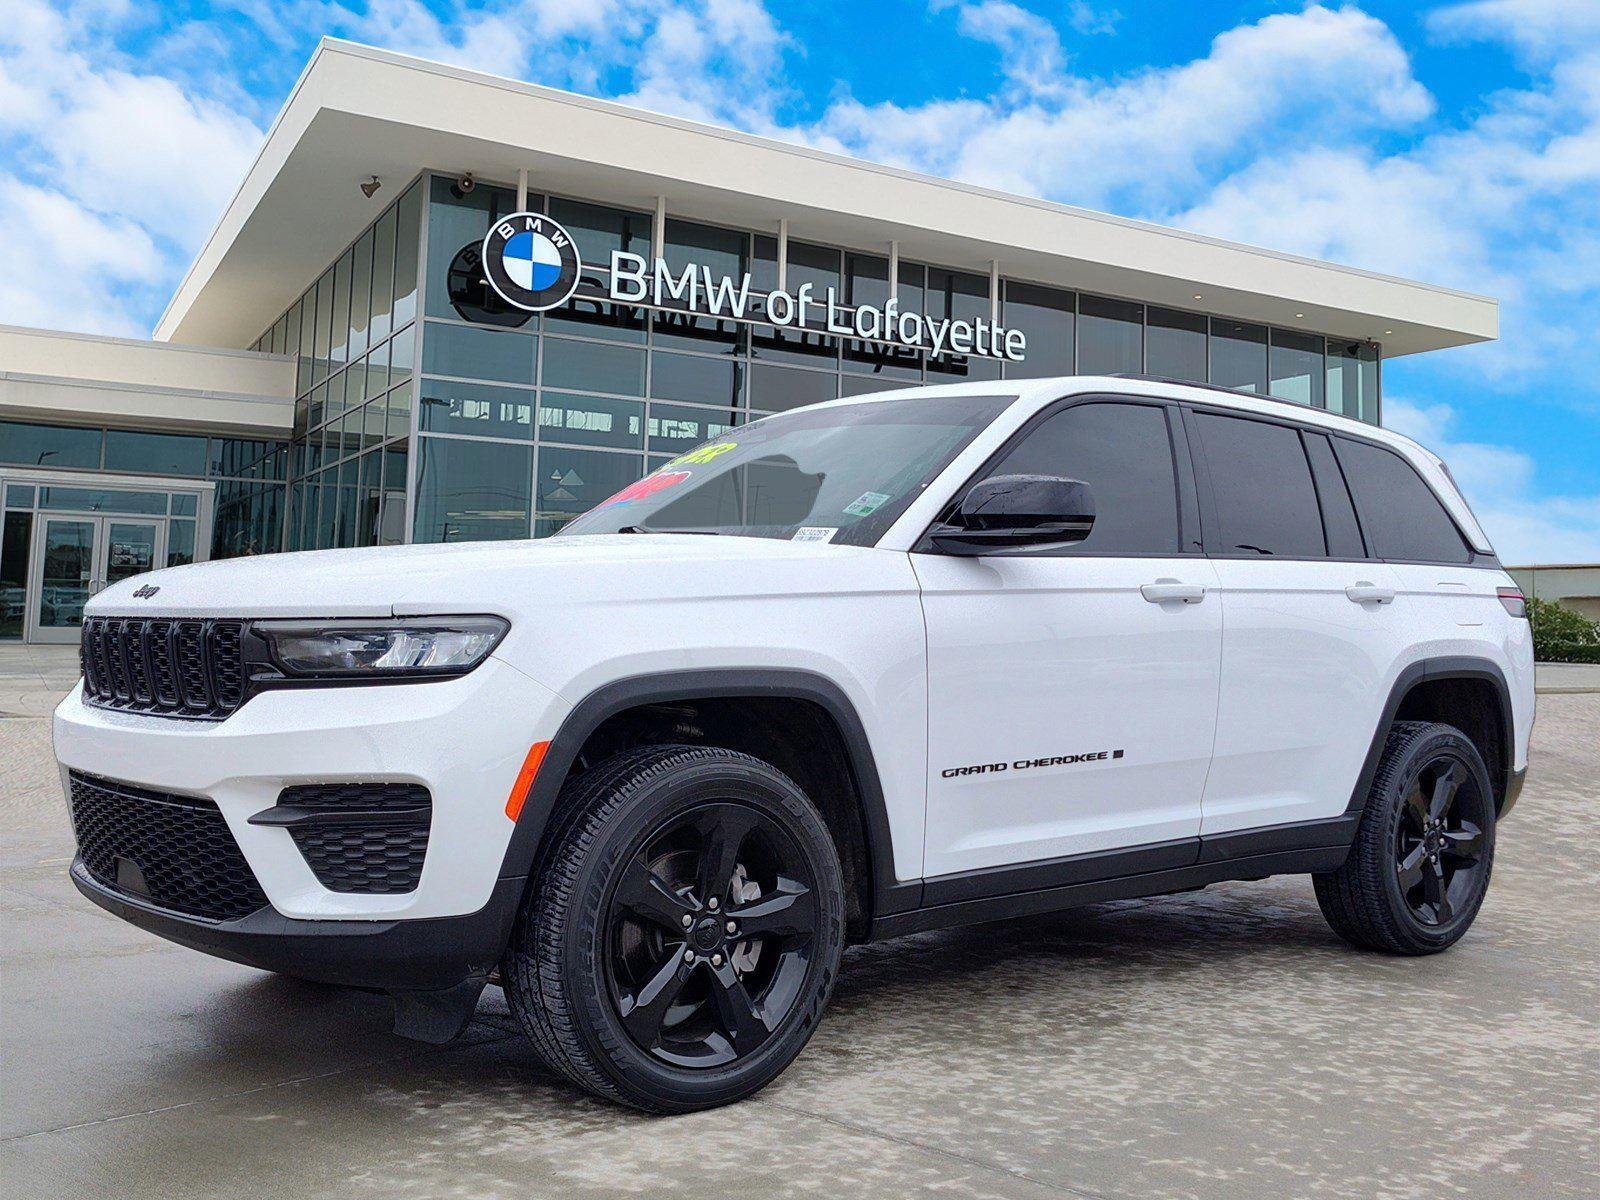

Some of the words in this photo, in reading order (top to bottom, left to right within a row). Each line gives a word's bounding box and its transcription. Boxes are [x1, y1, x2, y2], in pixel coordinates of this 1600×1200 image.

[497, 217, 569, 249] BMW
[609, 250, 751, 319] BMW
[766, 284, 813, 330] of
[827, 286, 1027, 362] Lafayette
[133, 584, 160, 600] Jeep
[942, 763, 1008, 778] GRAND
[1013, 751, 1108, 770] CHEROKEE
